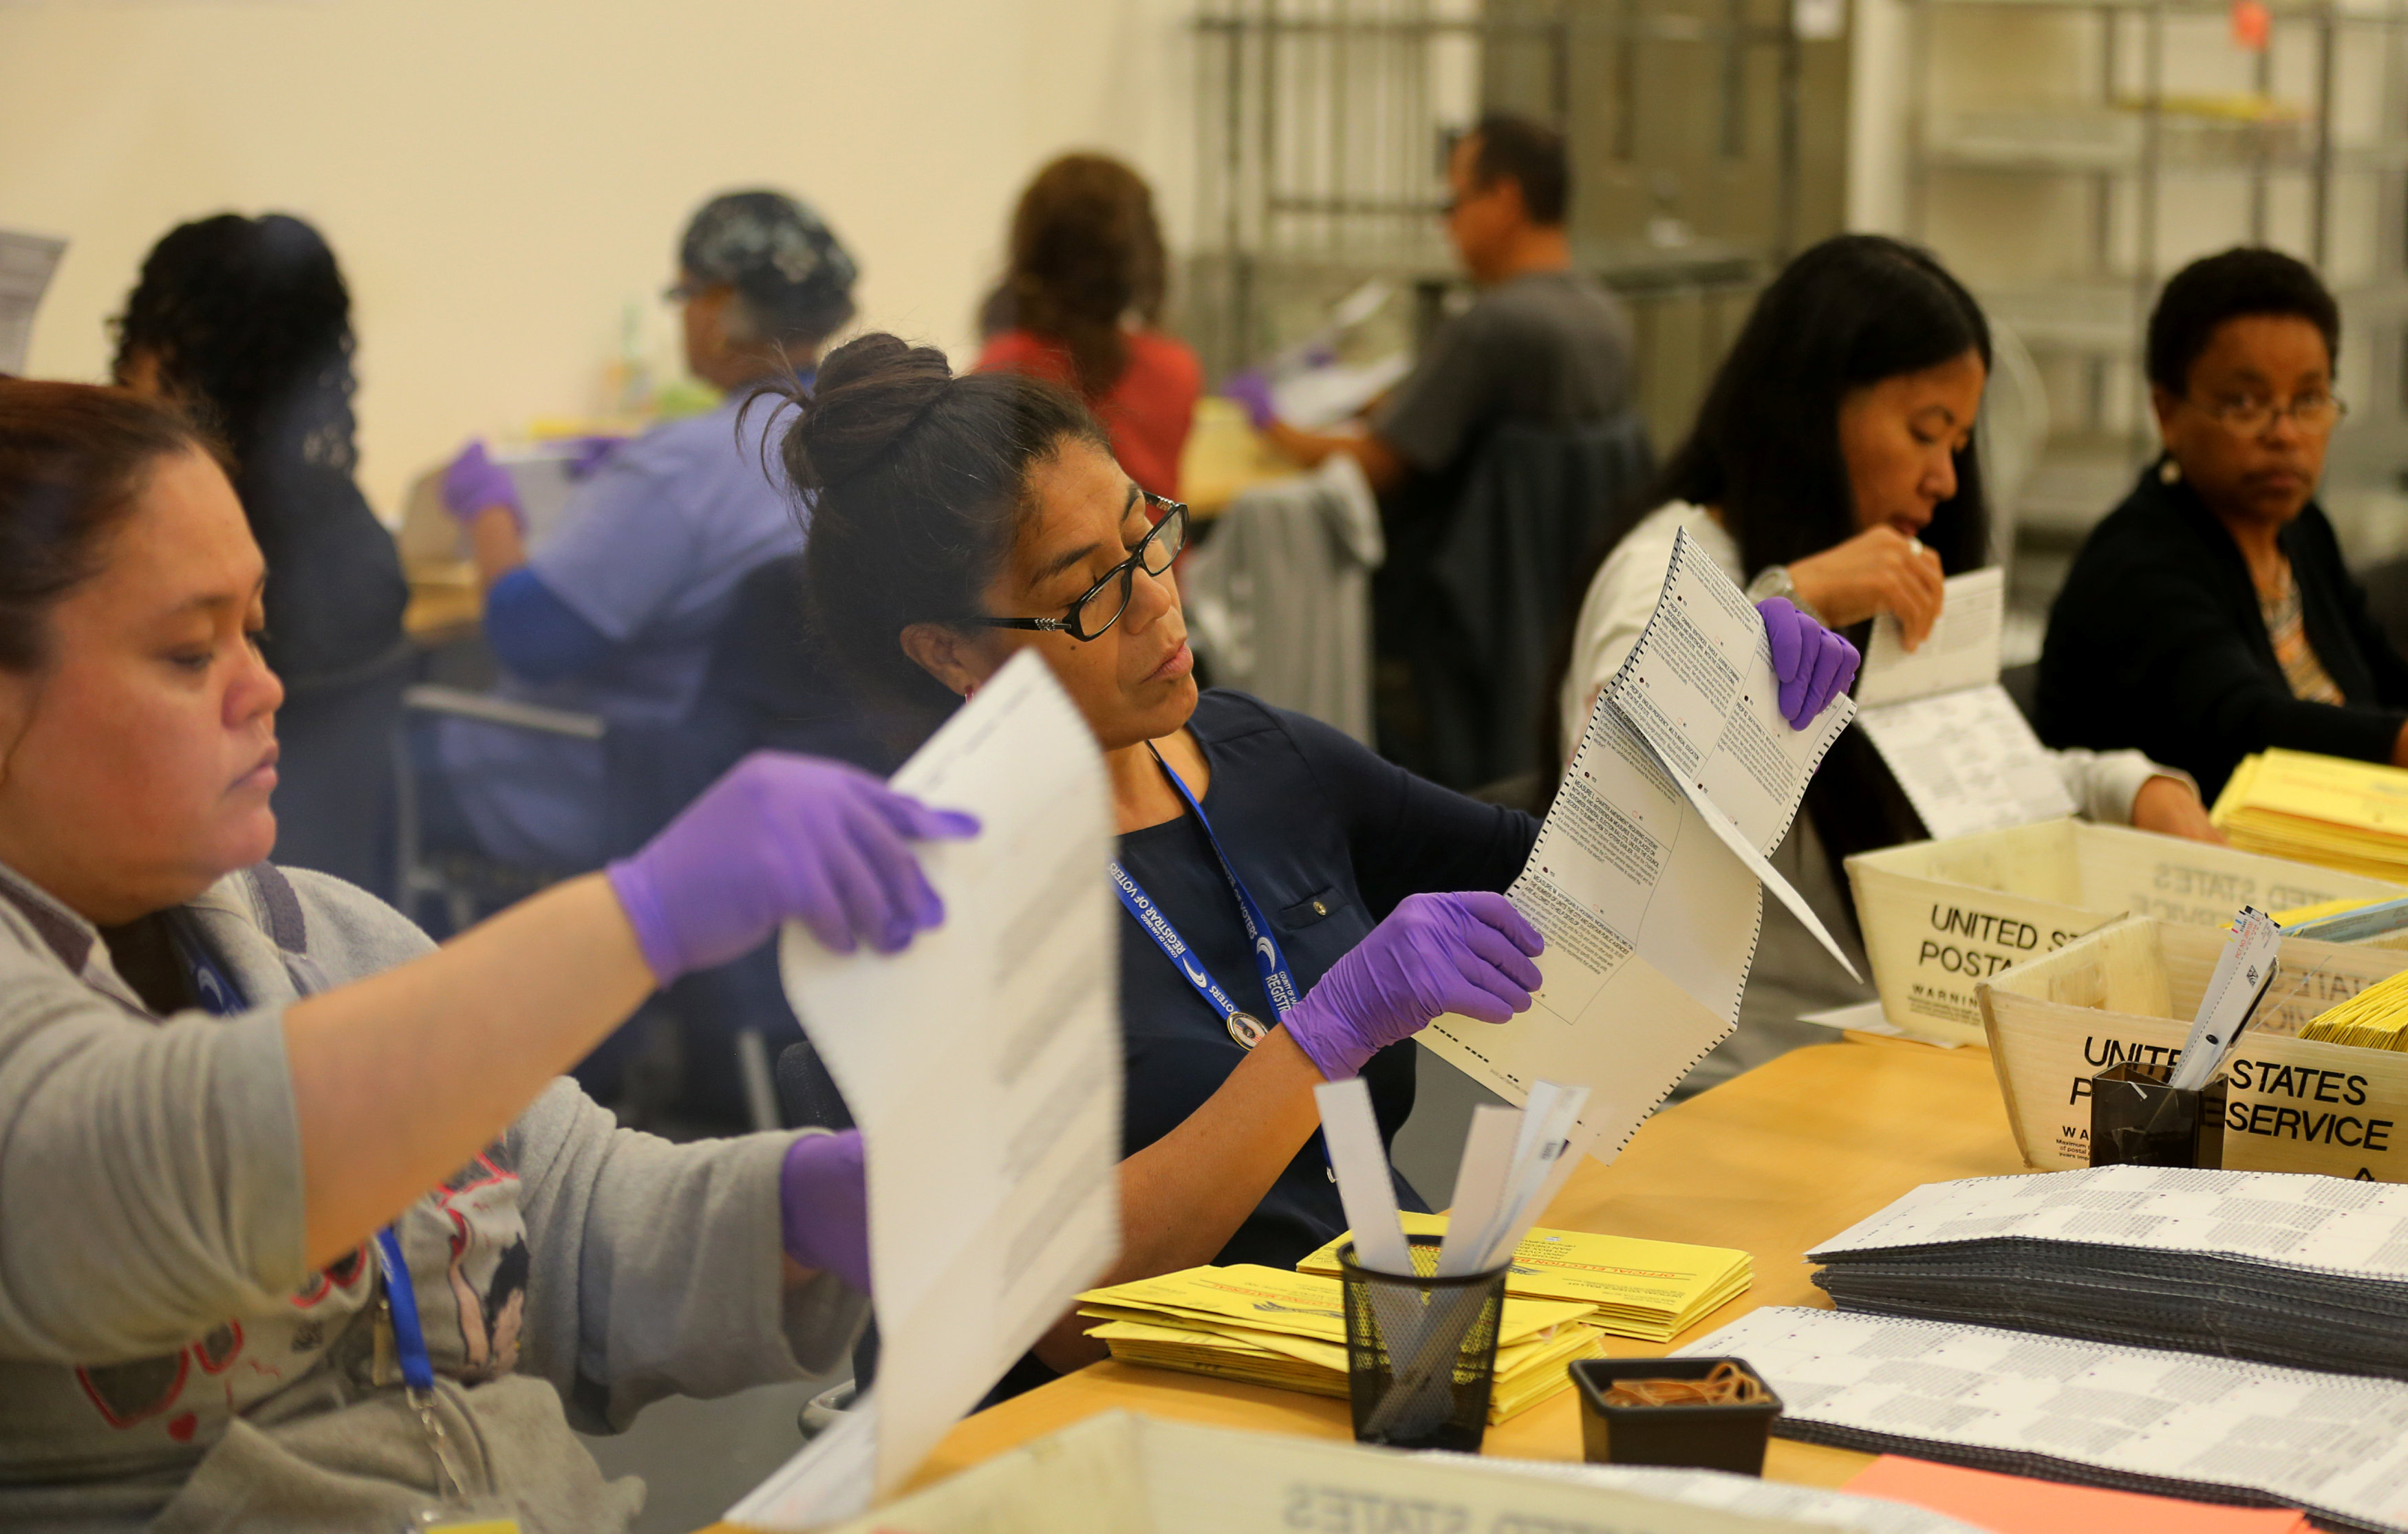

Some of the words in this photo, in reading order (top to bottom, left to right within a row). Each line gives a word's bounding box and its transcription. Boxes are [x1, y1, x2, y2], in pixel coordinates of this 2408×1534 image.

[1565, 797, 1580, 812] DECIDES
[1582, 811, 1595, 825] SUBMIT
[1593, 820, 1604, 832] THEM
[1607, 831, 1620, 845] VOTERS
[1573, 778, 1593, 798] MEASURE
[1594, 795, 1611, 812] CHARTER
[1609, 807, 1629, 828] AMENDMENT
[1627, 822, 1645, 841] REQUIRING
[1567, 791, 1587, 810] NOVEMBER
[1584, 804, 1600, 821] GENERAL
[1598, 816, 1615, 832] ELECTION
[1628, 839, 1641, 853] UNLESS
[1645, 853, 1660, 869] COUNCIL
[1585, 797, 1594, 808] AND
[1592, 803, 1614, 823] REFERENDUM
[1612, 819, 1630, 836] MEASURES
[1637, 839, 1651, 853] PLACED
[1106, 861, 1139, 897] VOTERS
[1535, 885, 1552, 899] NUMBER
[1134, 893, 1150, 909] OF
[1139, 912, 1153, 928] DIEGO
[1143, 906, 1186, 955] REGISTRAR
[1150, 925, 1160, 936] SAN
[1931, 904, 2037, 950] UNITED
[1157, 933, 1165, 942] OF
[1161, 940, 1178, 958] COUNTY
[2234, 947, 2243, 959] PCT
[1263, 973, 1292, 1014] REGISTR
[1277, 969, 1292, 991] COUNTY
[1286, 989, 1295, 998] OF
[1913, 984, 1979, 1008] WARNIN
[2228, 1059, 2368, 1105] STATES
[2226, 1102, 2394, 1151] SERVICE
[2056, 1139, 2087, 1149] Maximum
[1534, 1259, 1606, 1271] ELECTION
[1613, 1268, 1675, 1277] OFFICIAL
